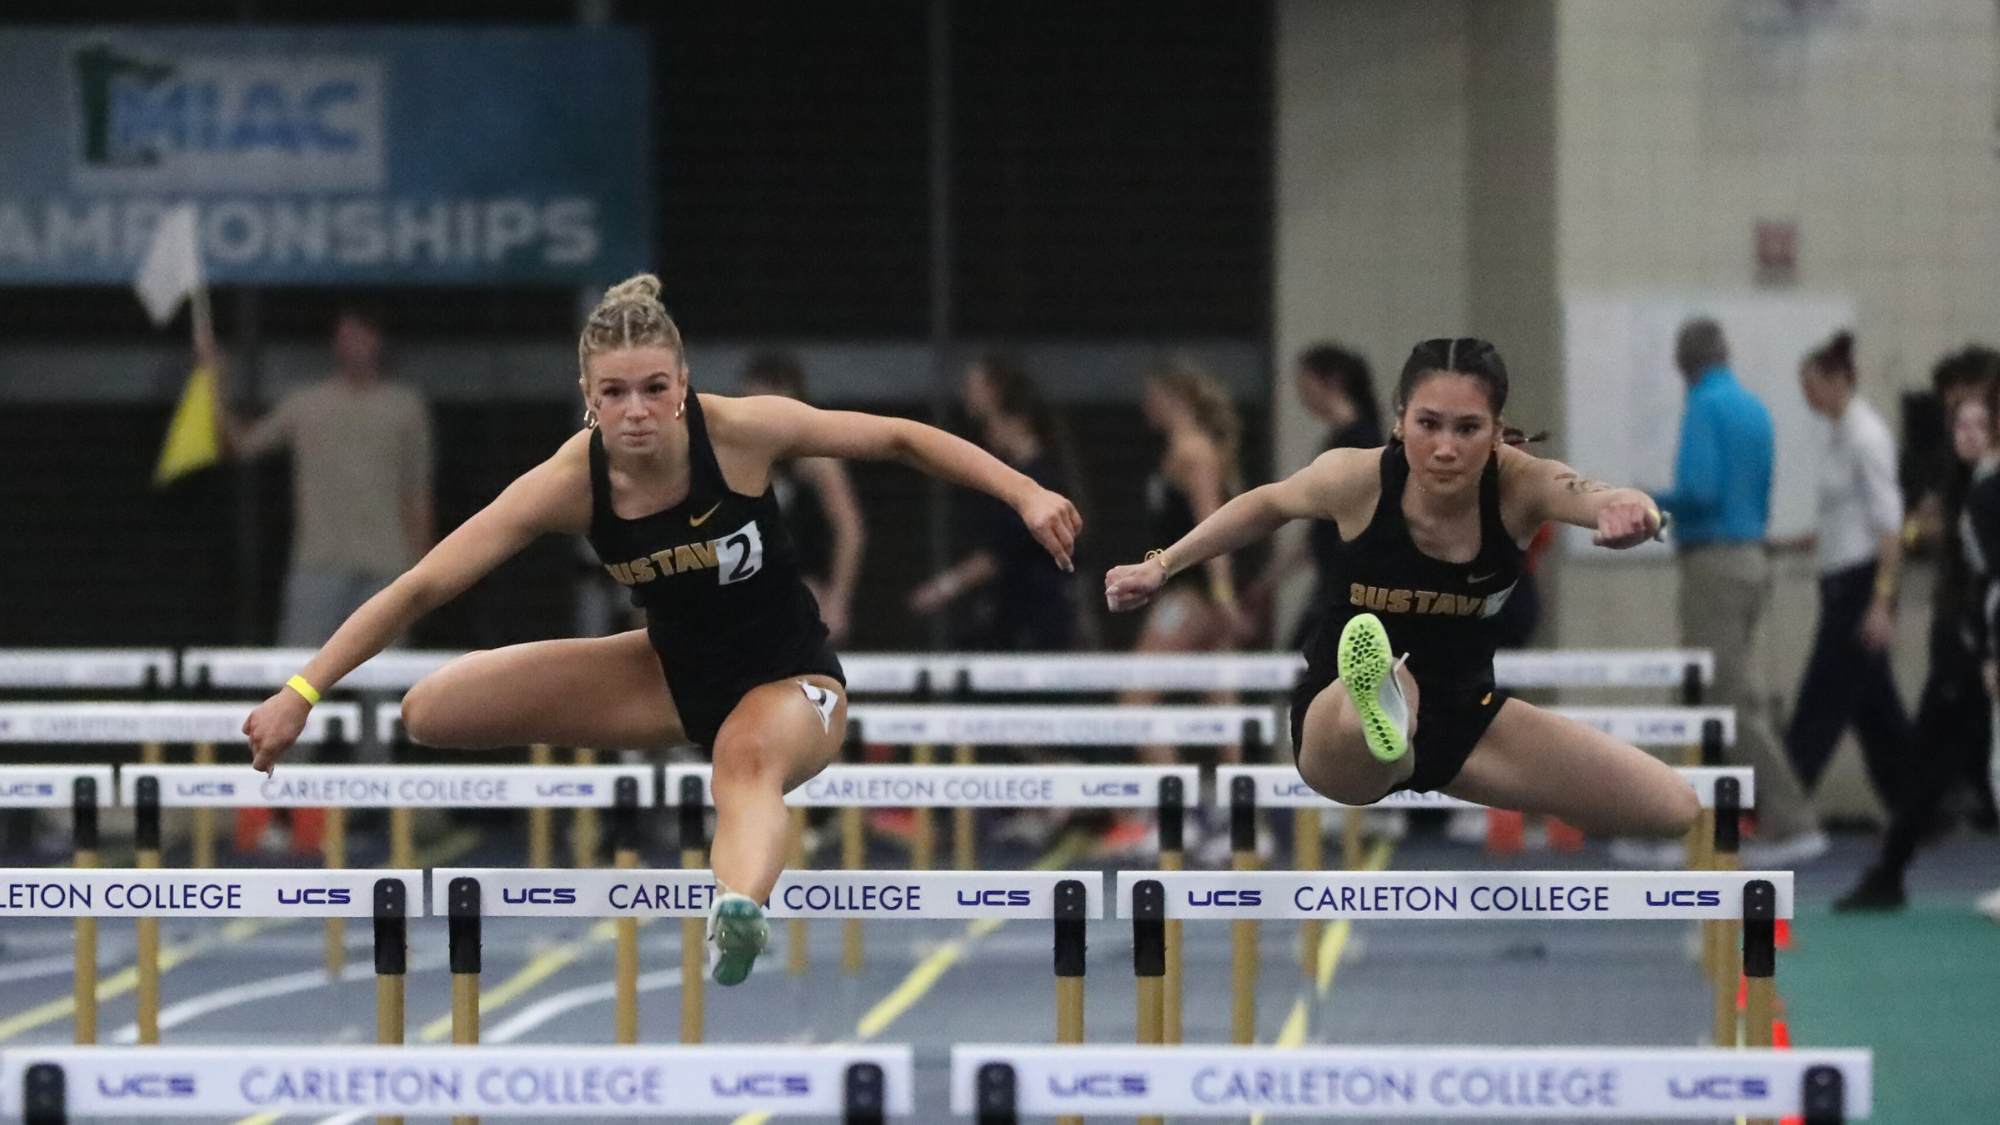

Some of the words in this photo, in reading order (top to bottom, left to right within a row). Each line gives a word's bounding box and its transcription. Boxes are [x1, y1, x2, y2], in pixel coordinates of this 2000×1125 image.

[110, 80, 361, 151] MIAC
[0, 199, 599, 263] AMPONSHIPS
[604, 541, 719, 585] USTAV
[726, 533, 754, 581] 2
[177, 783, 235, 797] UCS
[261, 776, 390, 800] CARLETON
[398, 777, 508, 801] COLLEGE
[536, 783, 594, 797] UCS
[805, 776, 933, 801] CARLETON
[943, 777, 1053, 801] COLLEGE
[1081, 783, 1140, 797] UCS
[105, 884, 241, 909] COLLEGE
[278, 887, 351, 905] UCS
[503, 887, 576, 905] UCS
[609, 884, 770, 910] CARLET
[783, 884, 920, 911] COLLEGE
[957, 889, 1030, 906] UCS
[1188, 889, 1262, 906] UCS
[1294, 885, 1457, 911] CARLETON
[1470, 885, 1609, 912] COLLEGE
[1645, 890, 1720, 907] UCS
[98, 1074, 197, 1098] UCS
[239, 1067, 461, 1106] CARLETON
[476, 1067, 662, 1106] COLLEGE
[711, 1074, 812, 1097] UCS
[1048, 1074, 1149, 1098] UCS
[1191, 1067, 1416, 1107] CARLETON
[1430, 1067, 1619, 1108] COLLEGE
[1668, 1076, 1770, 1101] UCS
